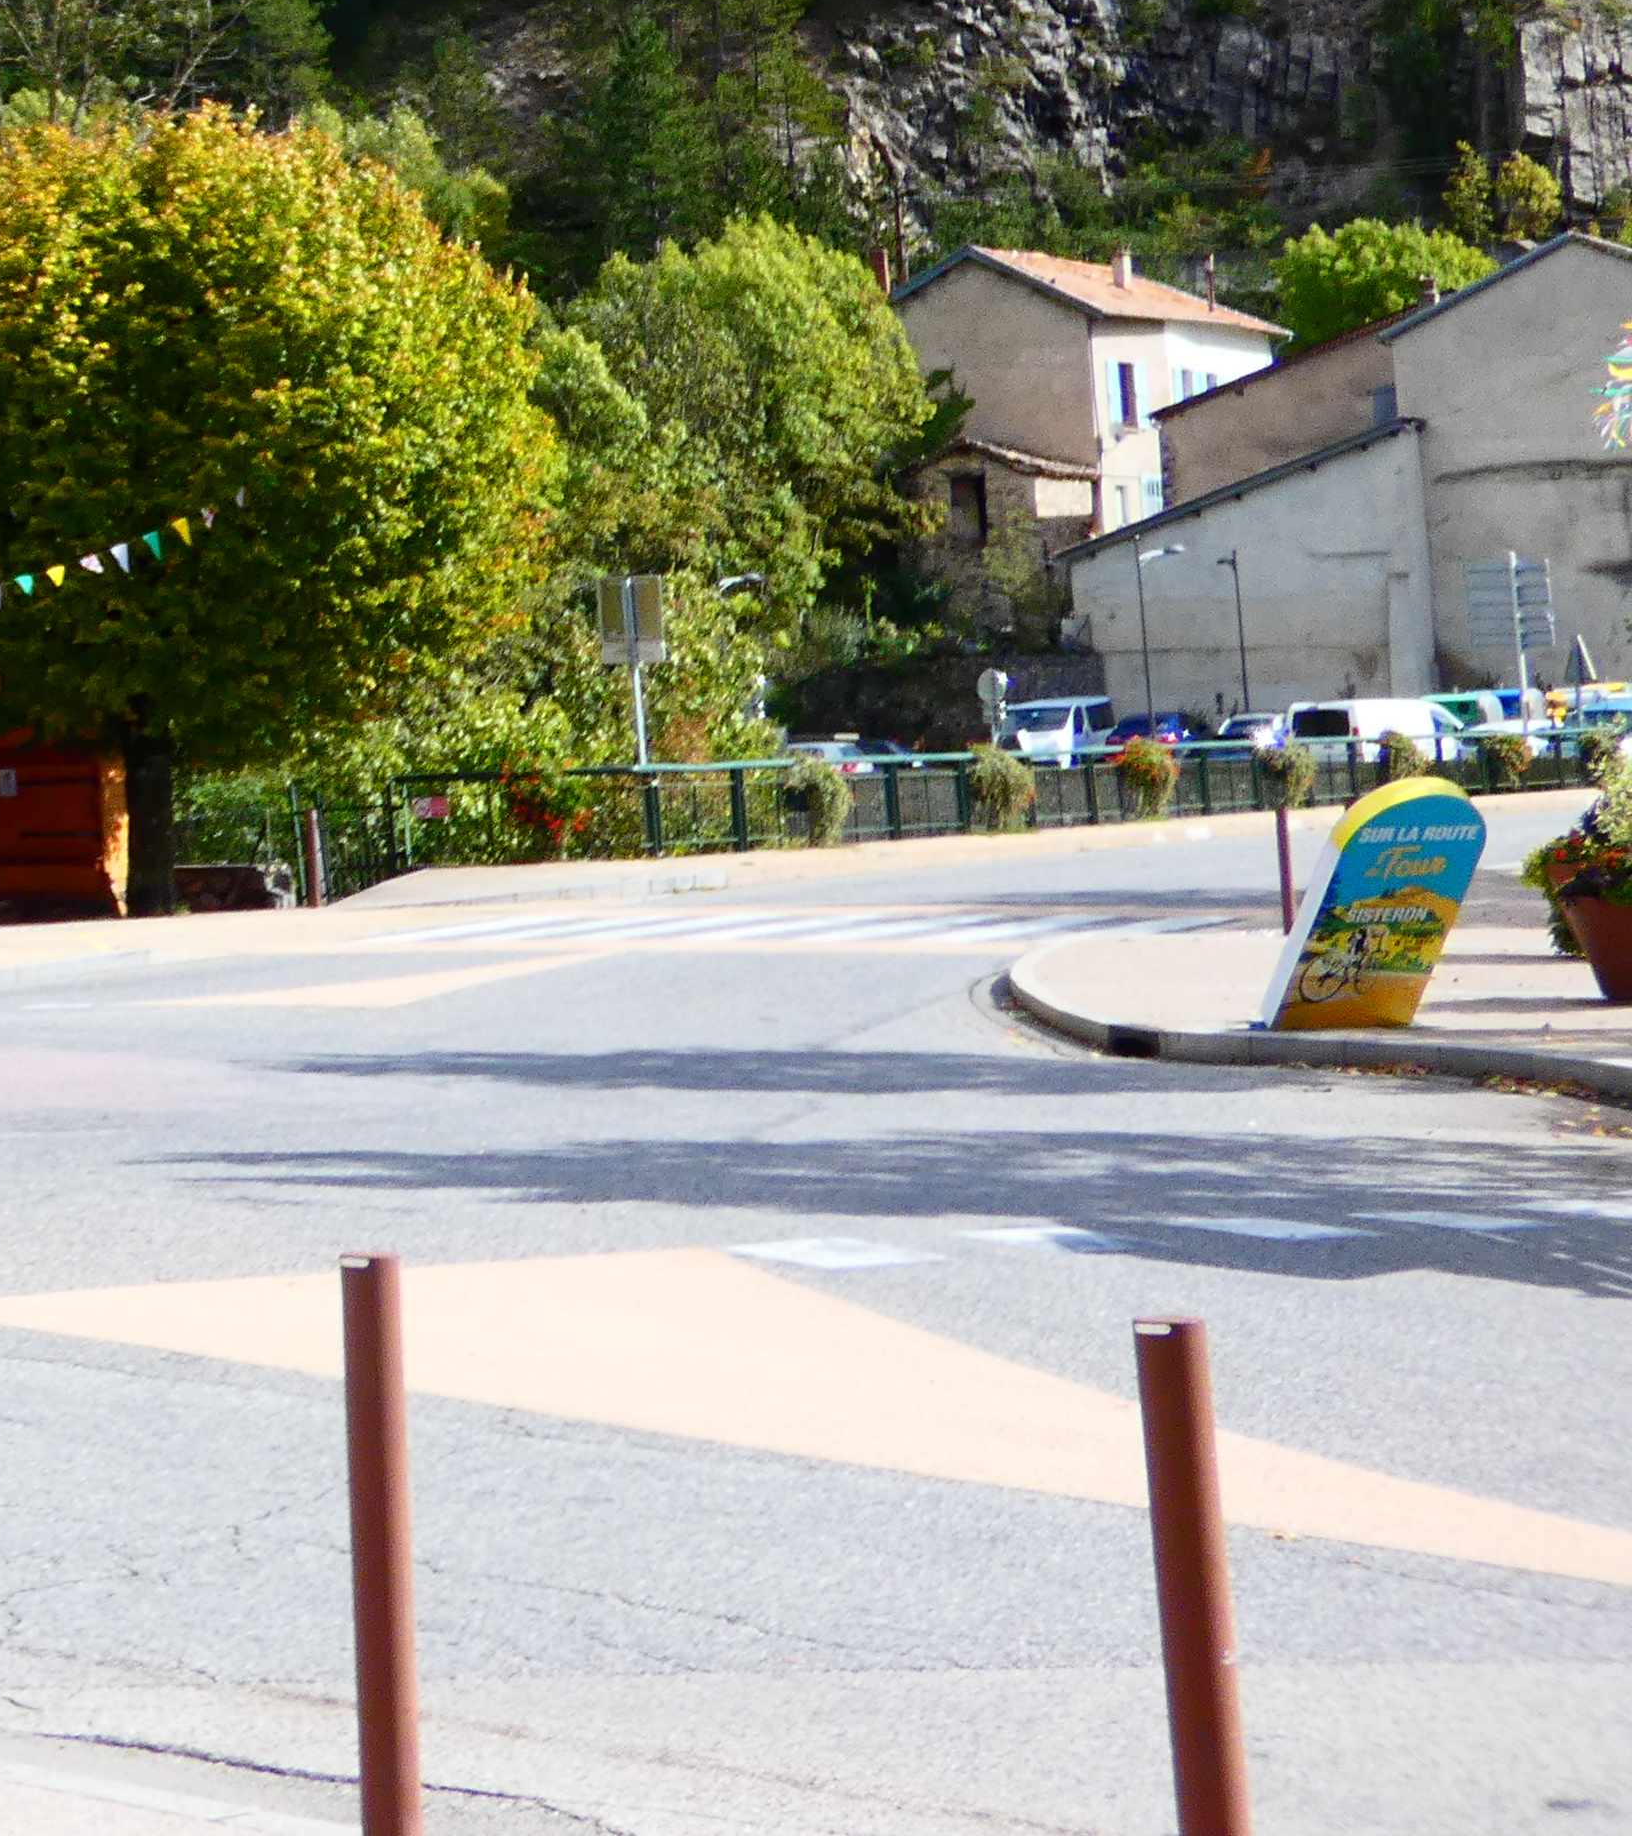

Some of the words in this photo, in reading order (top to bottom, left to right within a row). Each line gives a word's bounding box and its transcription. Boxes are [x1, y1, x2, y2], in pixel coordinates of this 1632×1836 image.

[1357, 826, 1396, 844] SUR
[1397, 825, 1420, 843] LA
[1421, 824, 1482, 842] ROUTE
